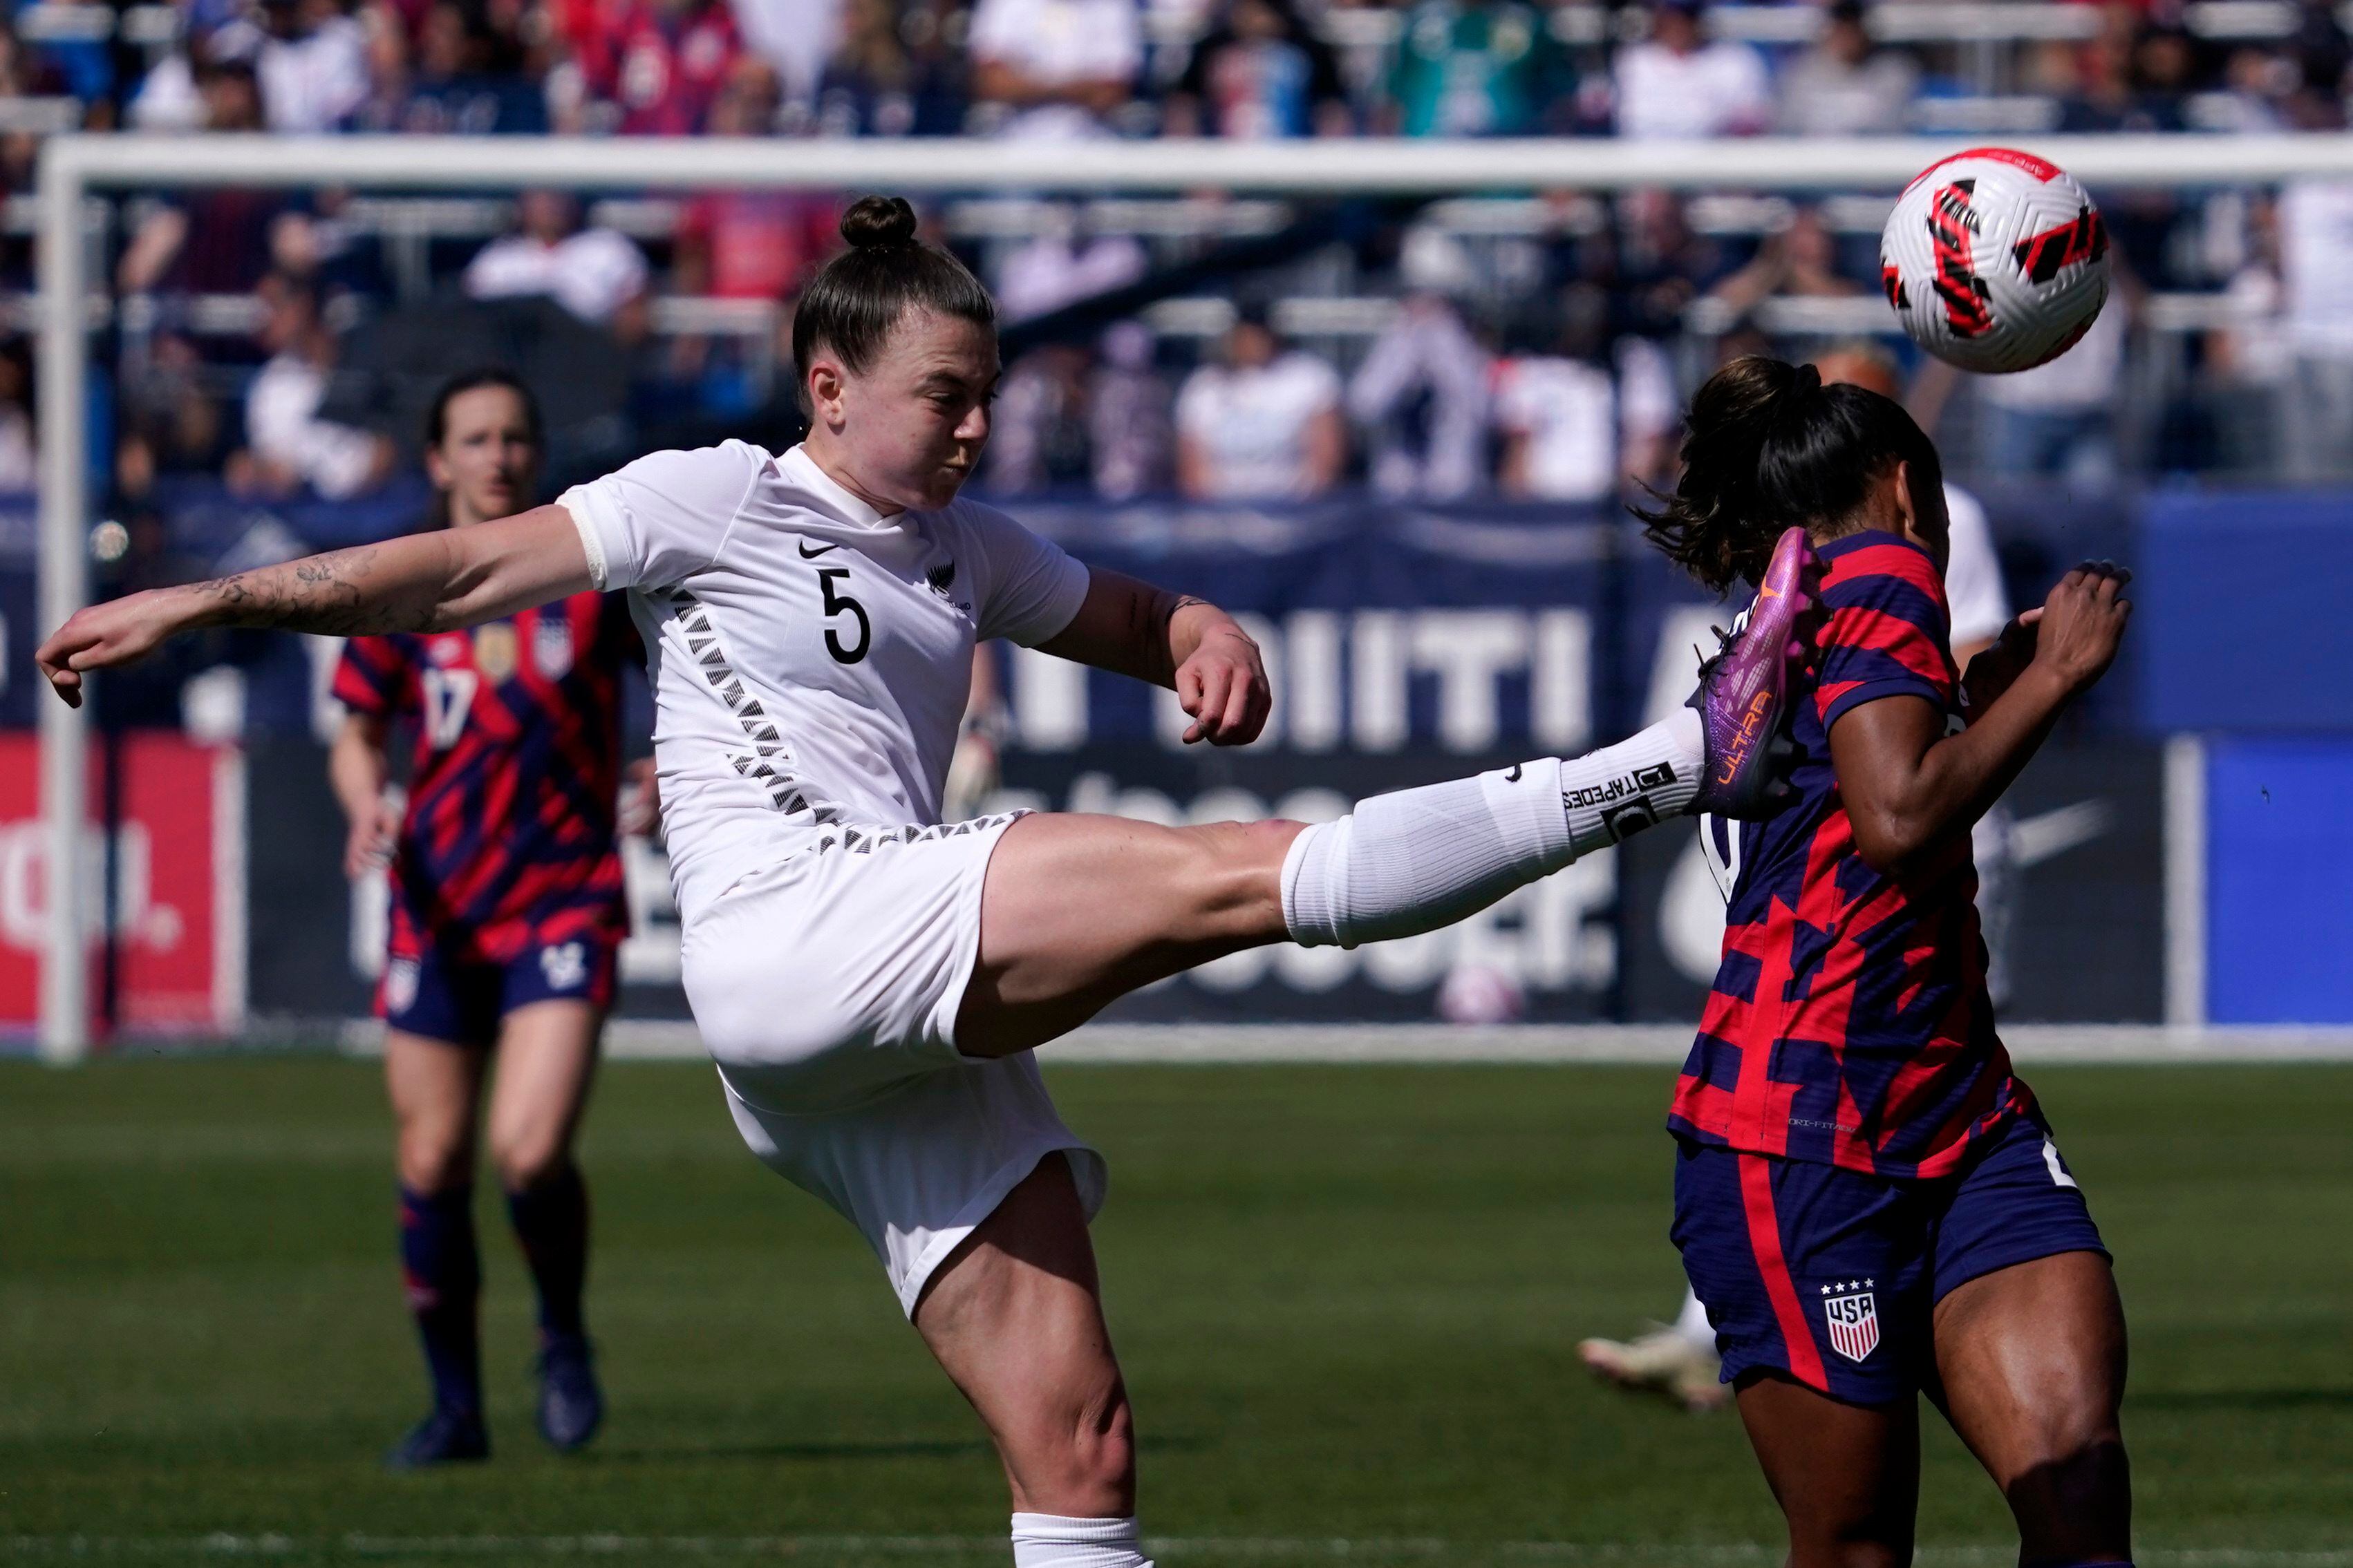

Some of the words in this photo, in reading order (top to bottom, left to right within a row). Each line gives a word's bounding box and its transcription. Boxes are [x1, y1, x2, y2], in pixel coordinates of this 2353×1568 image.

[816, 568, 871, 665] 5
[1718, 690, 1772, 785] ULTRA
[1828, 1296, 1873, 1324] USA
